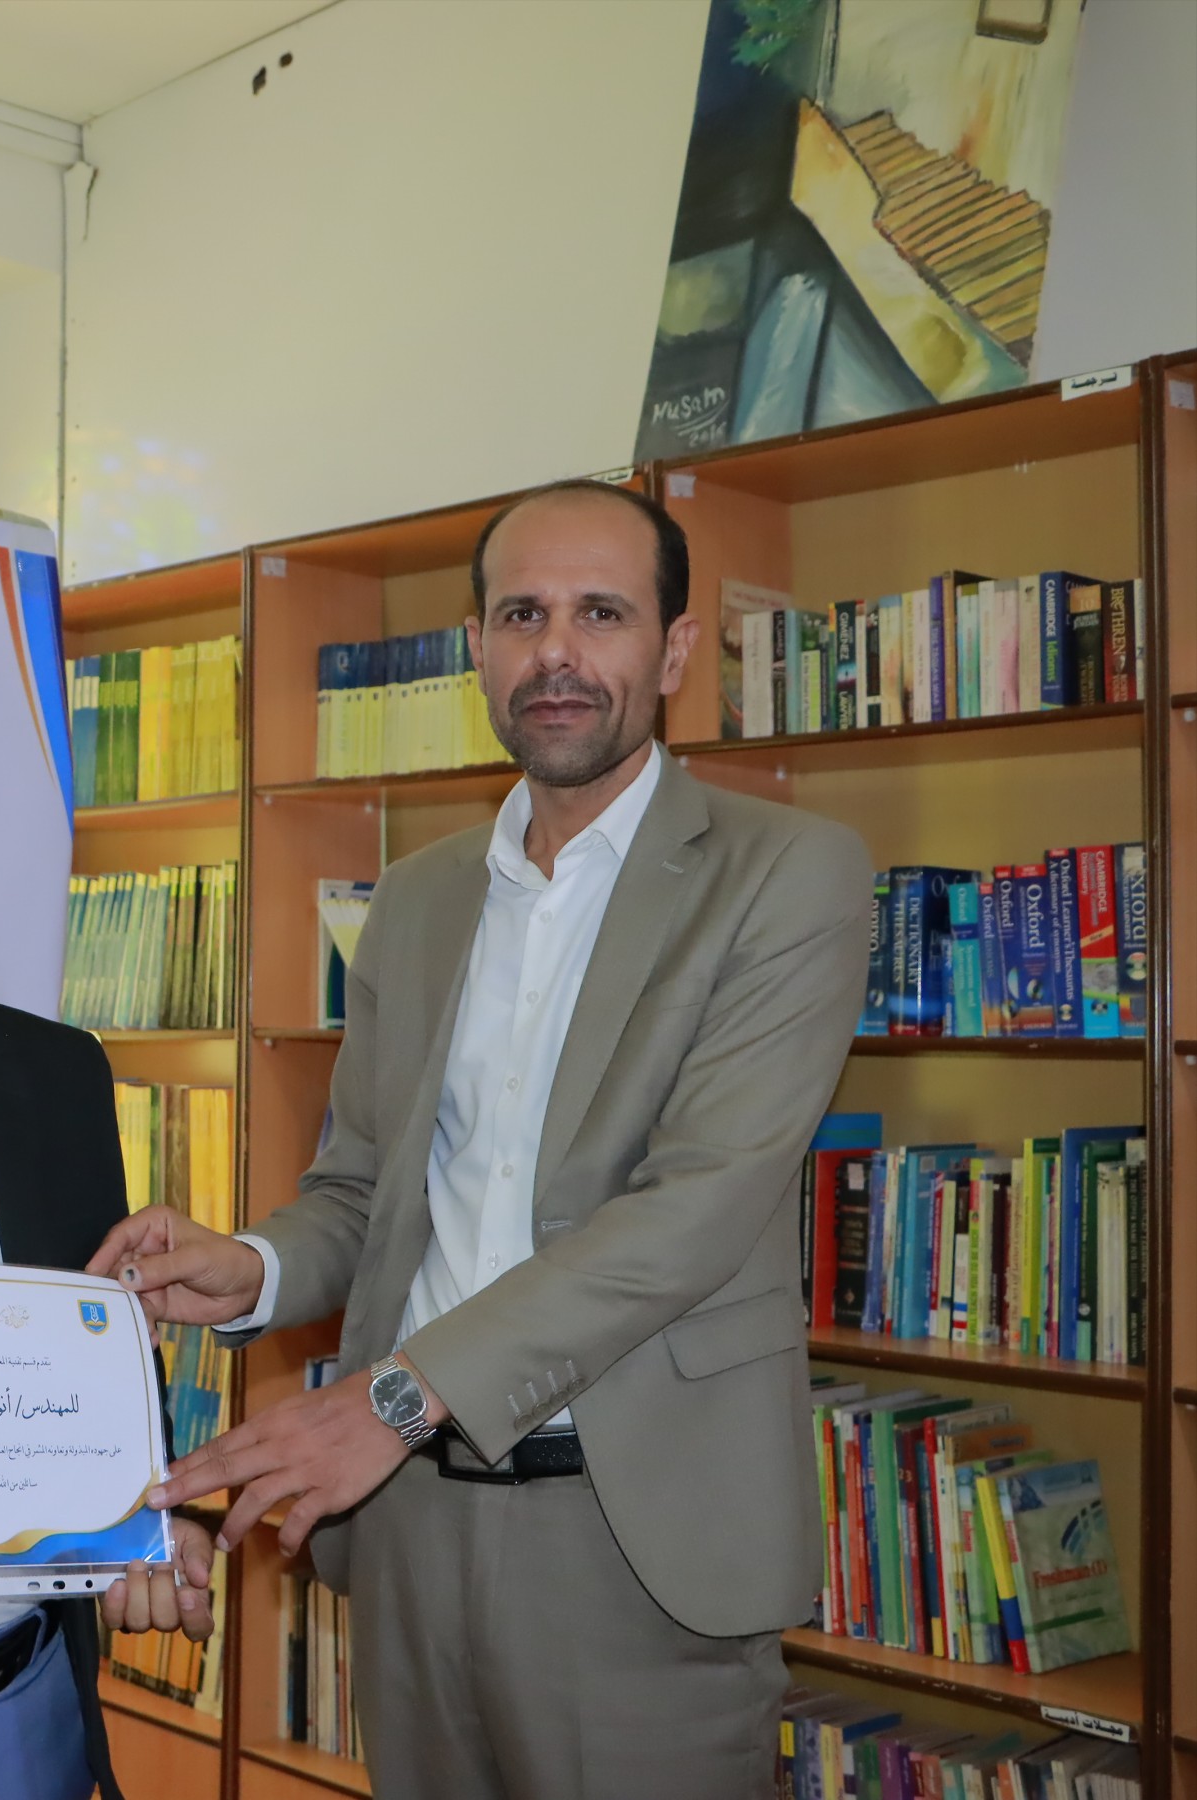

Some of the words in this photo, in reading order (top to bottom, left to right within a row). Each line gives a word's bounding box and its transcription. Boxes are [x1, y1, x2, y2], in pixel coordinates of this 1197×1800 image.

[1045, 579, 1057, 637] CAMBRIDGE
[839, 611, 850, 660] GIMENEZ
[1047, 641, 1058, 682] Idioms
[839, 690, 848, 731] LAWYER
[1060, 858, 1073, 898] Oxford
[1096, 850, 1107, 913] CAMBRIDGE
[958, 887, 967, 922] Oxford
[983, 896, 995, 939] Oxford
[1000, 880, 1014, 929] Oxford
[1026, 883, 1045, 949] Oxford
[1062, 900, 1074, 949] Learner's
[893, 902, 904, 983] THESAURUS
[908, 896, 920, 985] DICTIONARY
[1064, 950, 1075, 1000] Thesaurus
